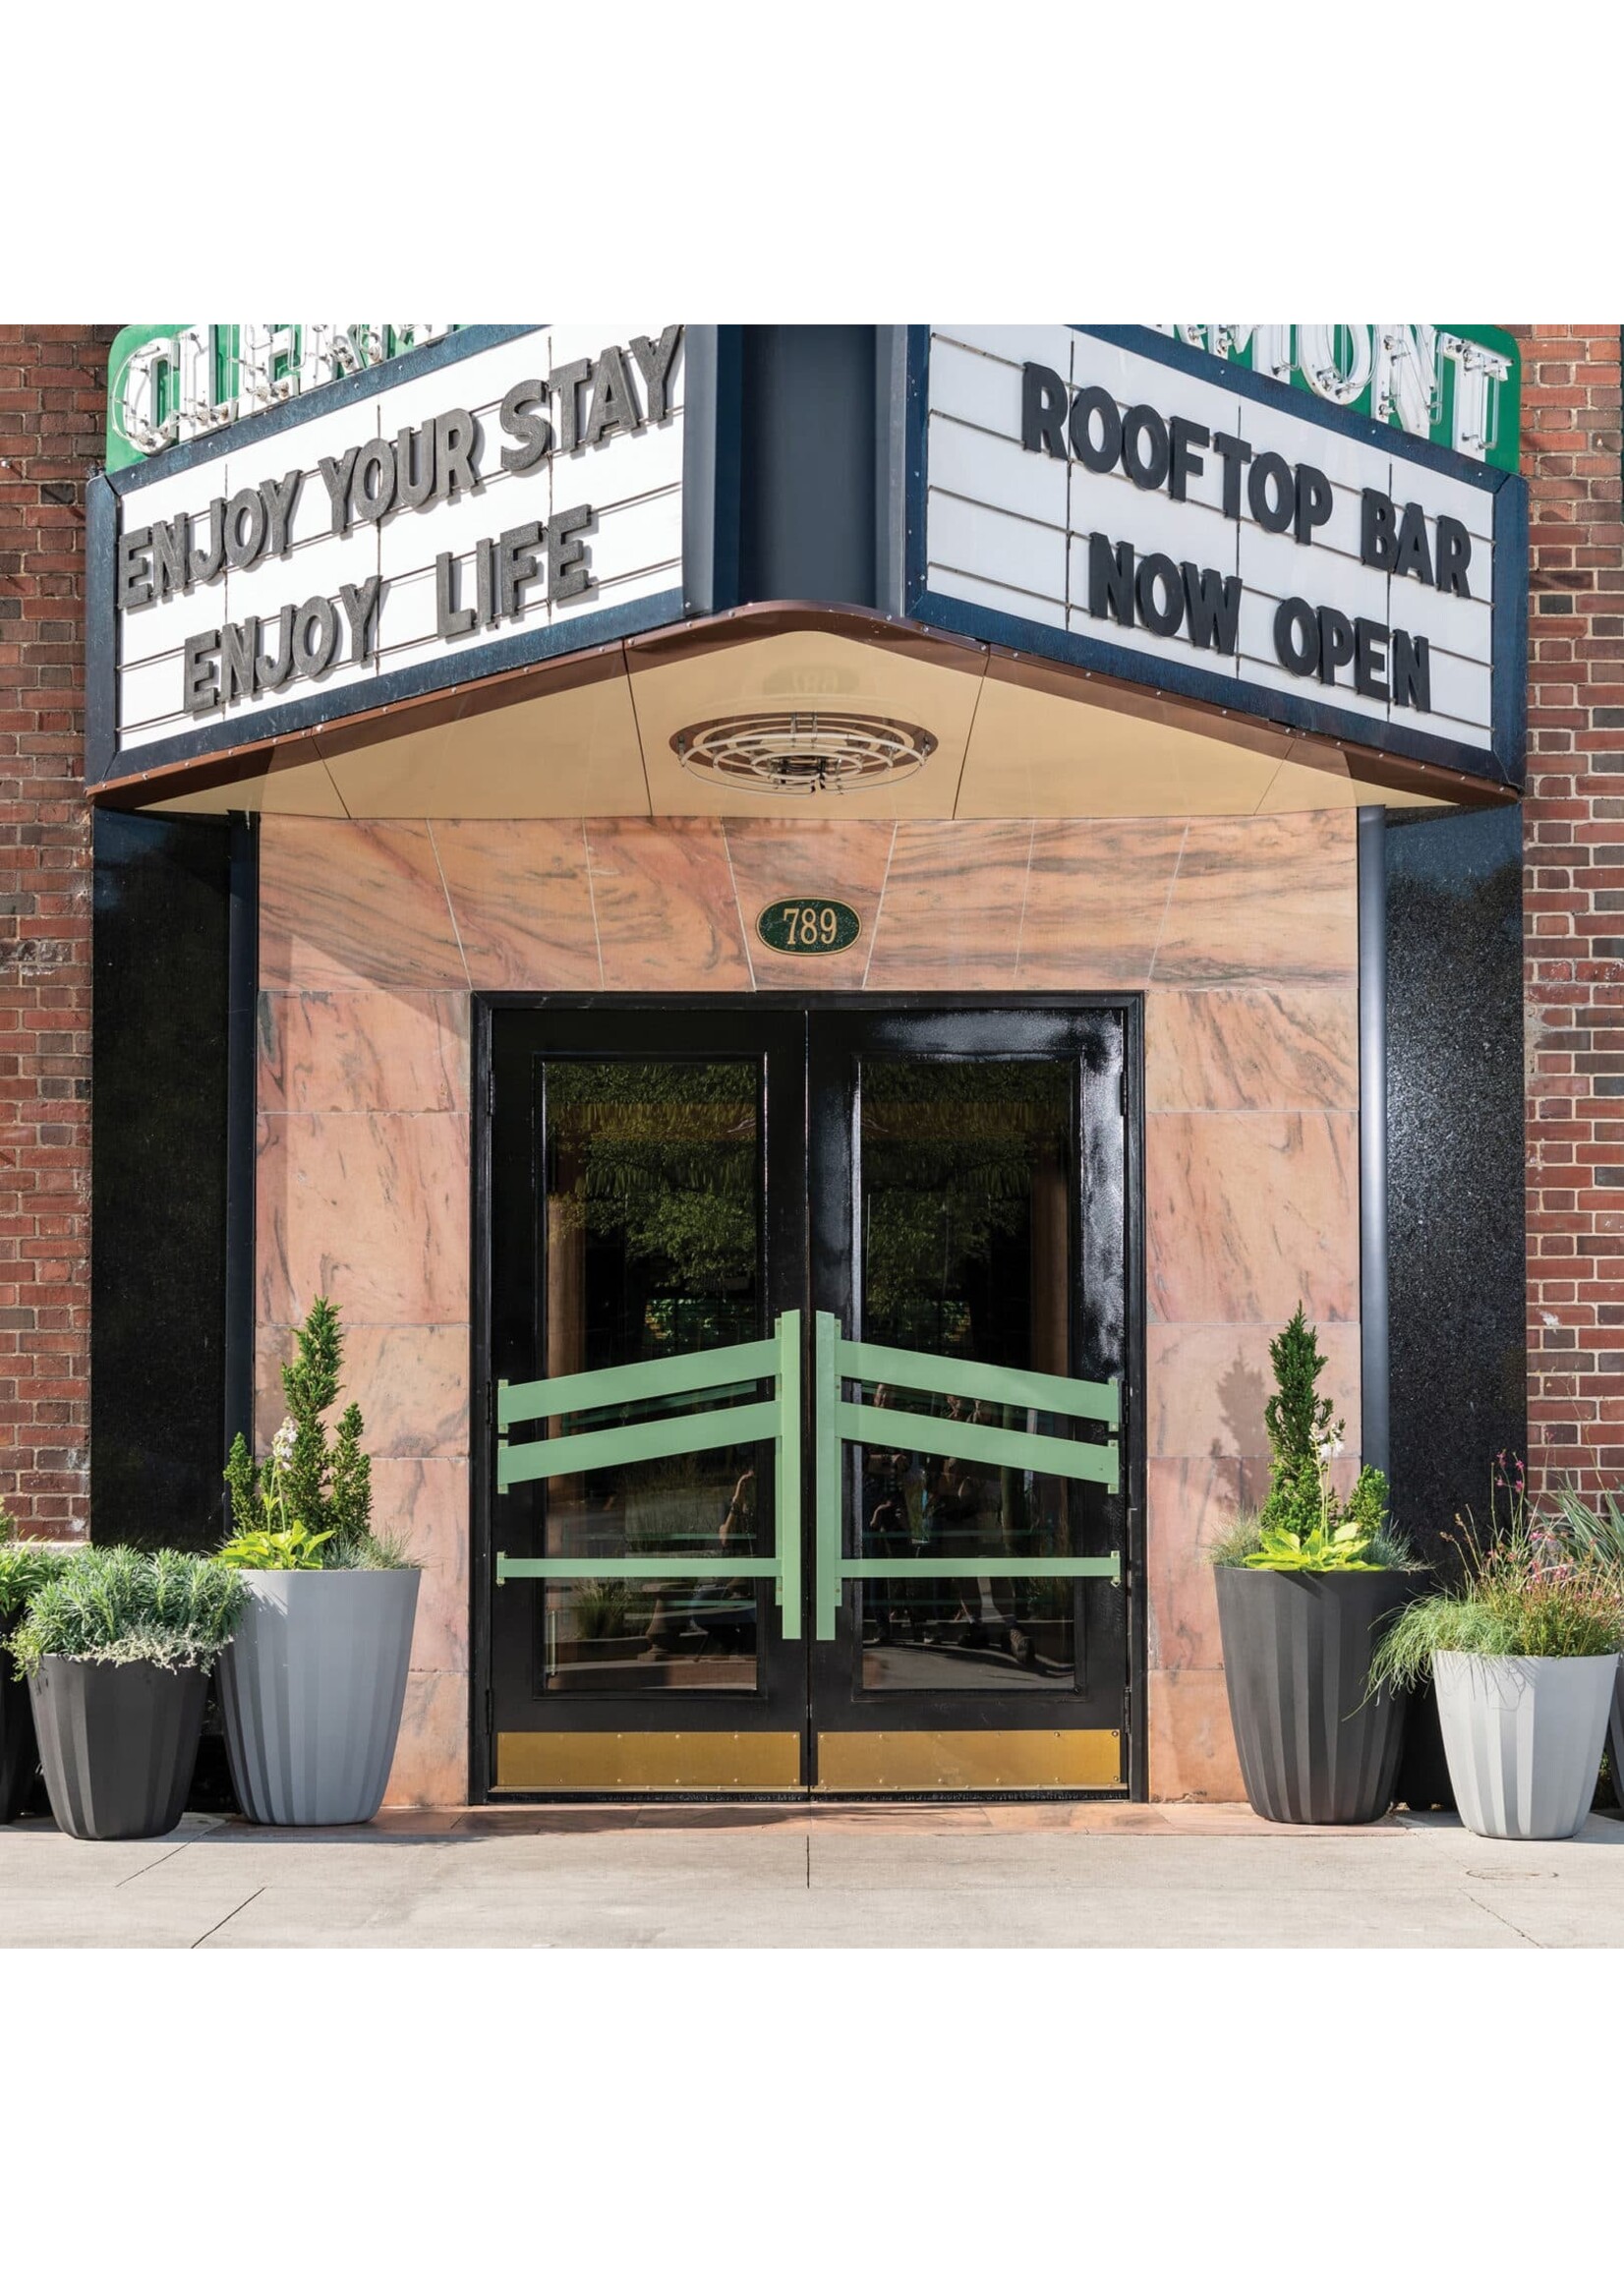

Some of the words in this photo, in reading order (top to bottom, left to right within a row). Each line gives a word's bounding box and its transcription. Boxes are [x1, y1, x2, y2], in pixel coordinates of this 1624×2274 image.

[118, 469, 302, 610] ENJOY
[318, 408, 482, 535] YOUR
[500, 325, 685, 472] STAY
[1361, 488, 1471, 598] BAR
[184, 576, 381, 713] ENJOY
[436, 504, 591, 639] LIFE
[1088, 532, 1242, 656] NOW
[1273, 597, 1430, 713] OPEN
[783, 907, 837, 945] 789
